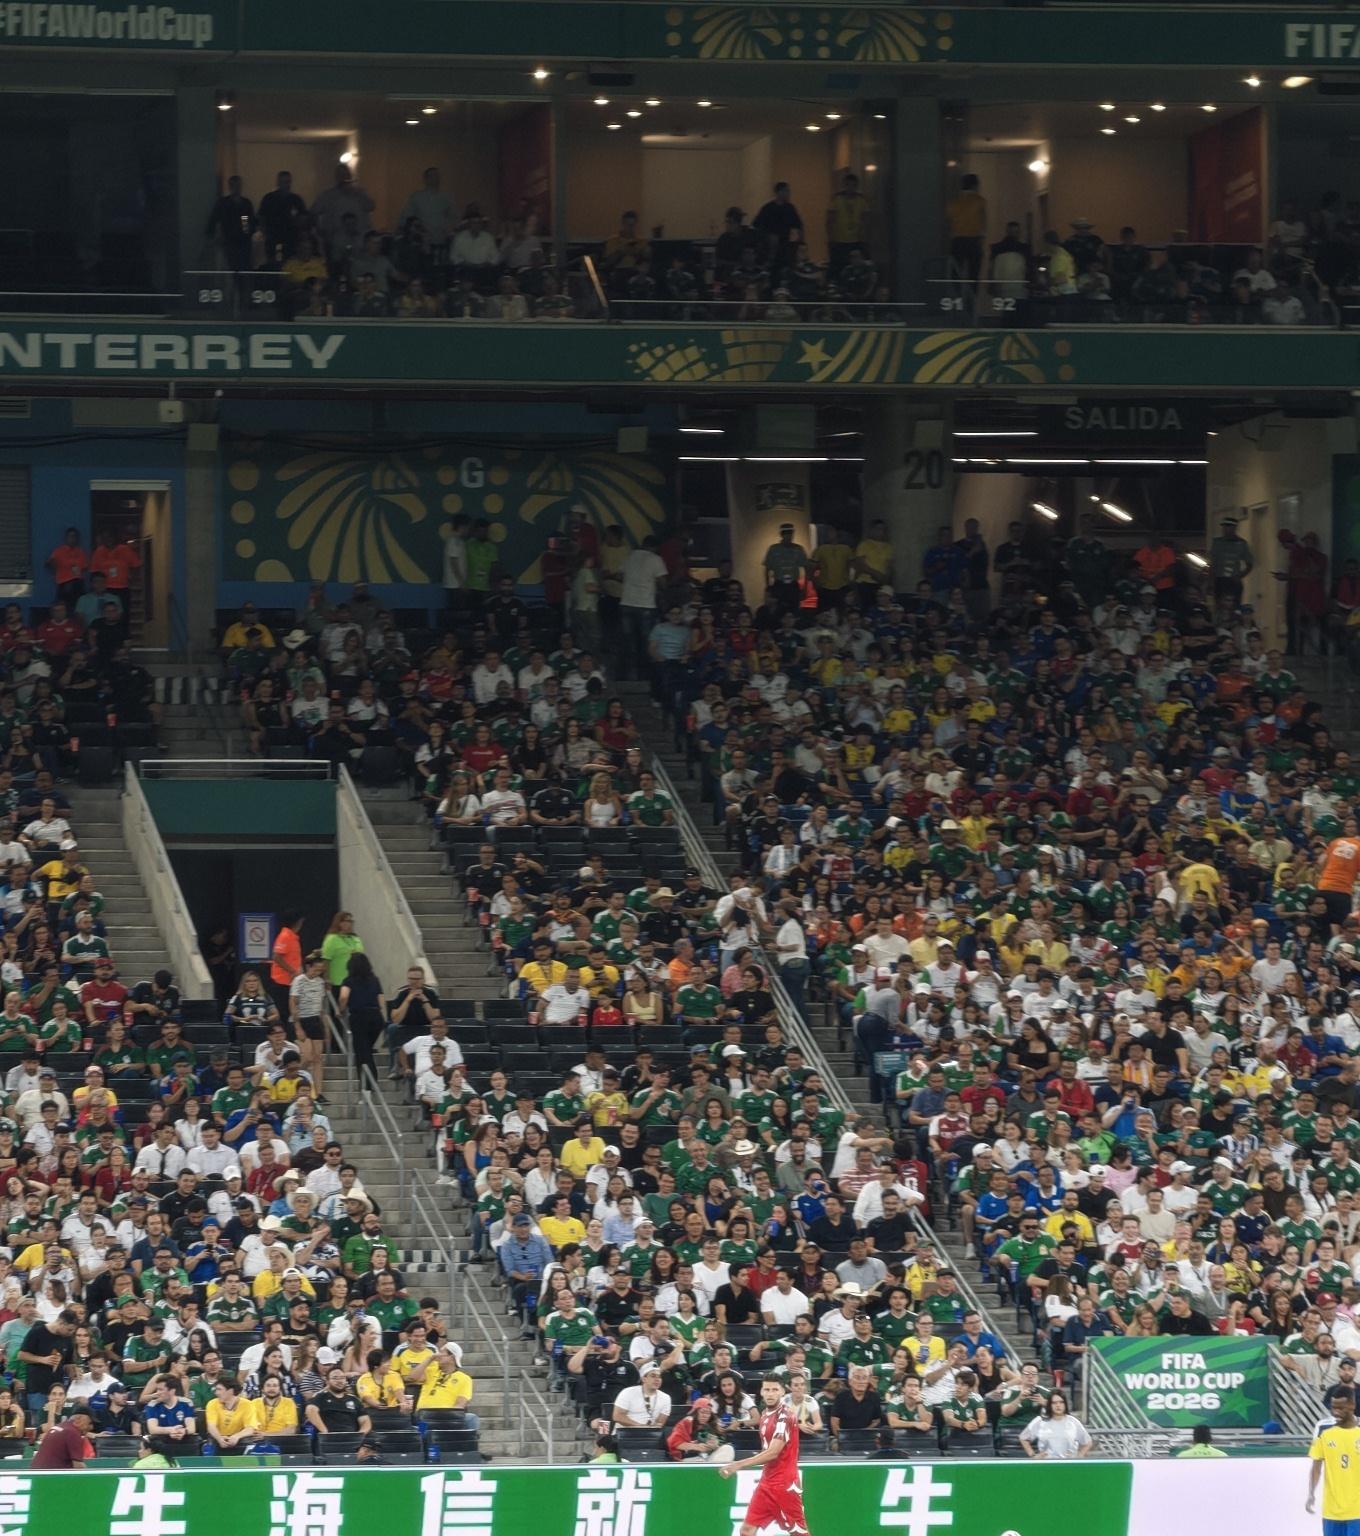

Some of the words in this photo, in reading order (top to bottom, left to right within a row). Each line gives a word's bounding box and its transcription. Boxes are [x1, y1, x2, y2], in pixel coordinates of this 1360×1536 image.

[198, 289, 223, 303] 89
[251, 289, 277, 304] 90
[940, 297, 964, 311] 91
[992, 297, 1017, 312] 92
[1064, 407, 1184, 431] SALIDA
[461, 456, 485, 489] G
[904, 450, 945, 490] 20
[1161, 1353, 1207, 1370] FIFA
[1124, 1372, 1201, 1390] WORLD
[1202, 1372, 1246, 1389] CUP
[1146, 1392, 1221, 1410] 2026
[1341, 1454, 1349, 1470] 9
